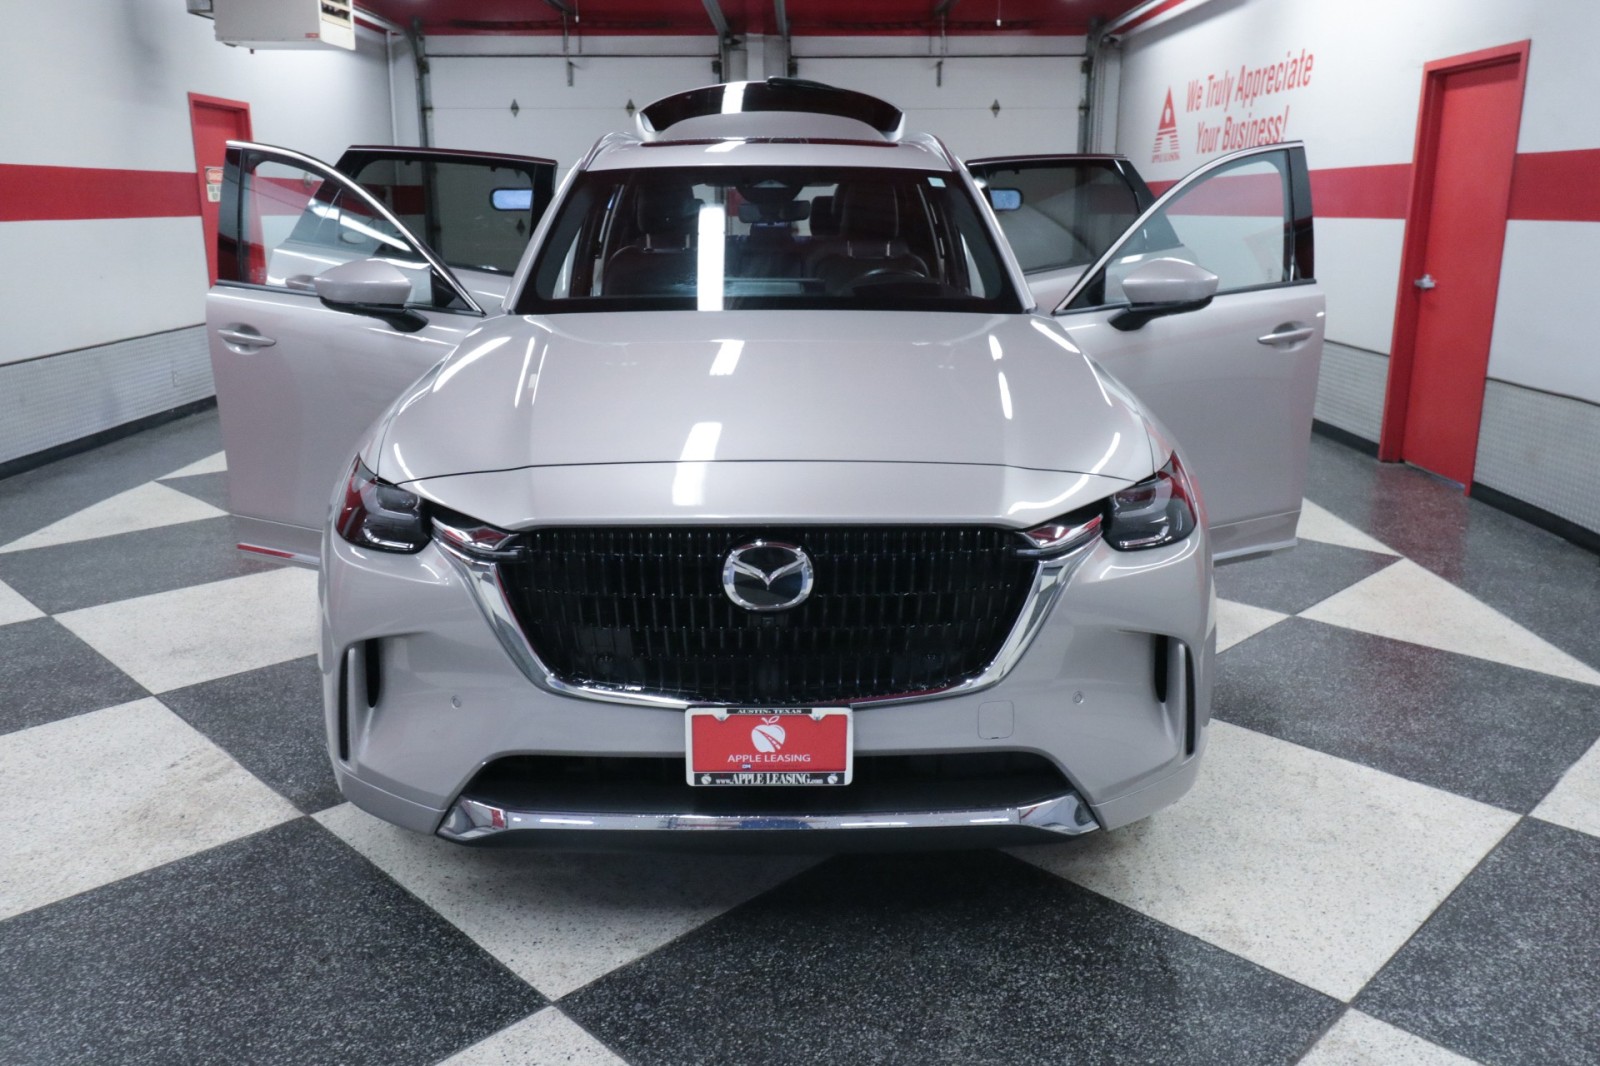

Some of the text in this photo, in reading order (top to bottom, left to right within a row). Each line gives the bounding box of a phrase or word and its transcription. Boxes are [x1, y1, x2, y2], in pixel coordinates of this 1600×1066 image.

[1186, 48, 1314, 113] We Truly Appreciate
[1196, 105, 1289, 154] Your Business!
[727, 754, 811, 763] APPLE LEASING
[715, 773, 824, 785] www.APPLE LEASING.com
